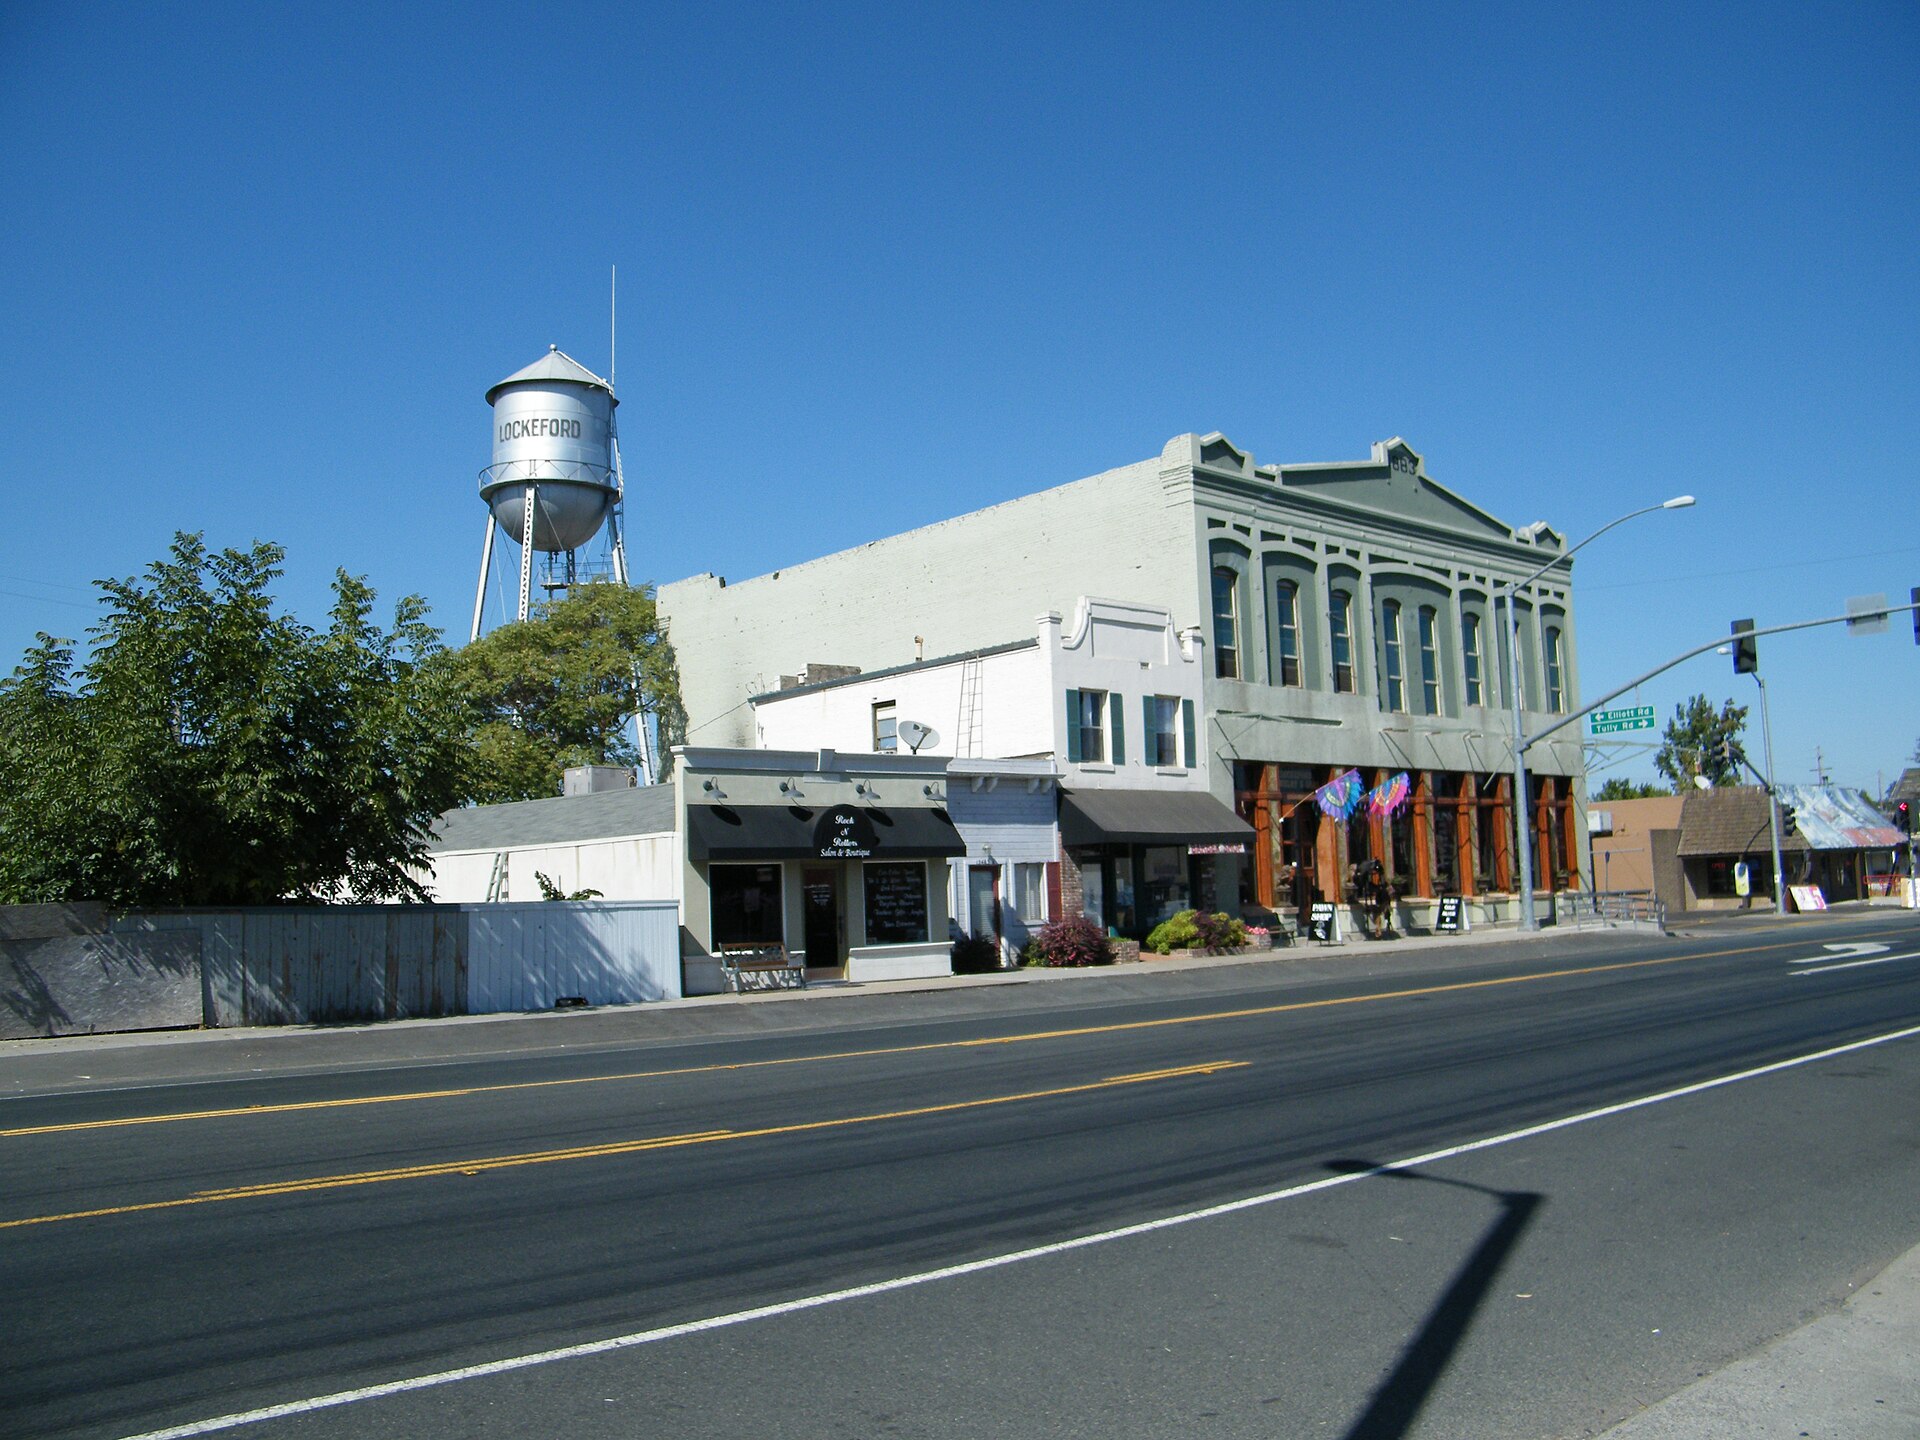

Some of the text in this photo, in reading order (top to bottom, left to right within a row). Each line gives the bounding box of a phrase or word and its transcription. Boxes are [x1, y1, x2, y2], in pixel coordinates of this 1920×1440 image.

[499, 418, 581, 442] LOCKEFORD
[1607, 708, 1649, 720] Elliott Rd
[1596, 722, 1634, 733] Tully Rd
[834, 814, 855, 825] Rock
[820, 847, 870, 858] Salon & Boutique
[1312, 903, 1334, 912] PAWN
[1310, 912, 1332, 922] SHOP
